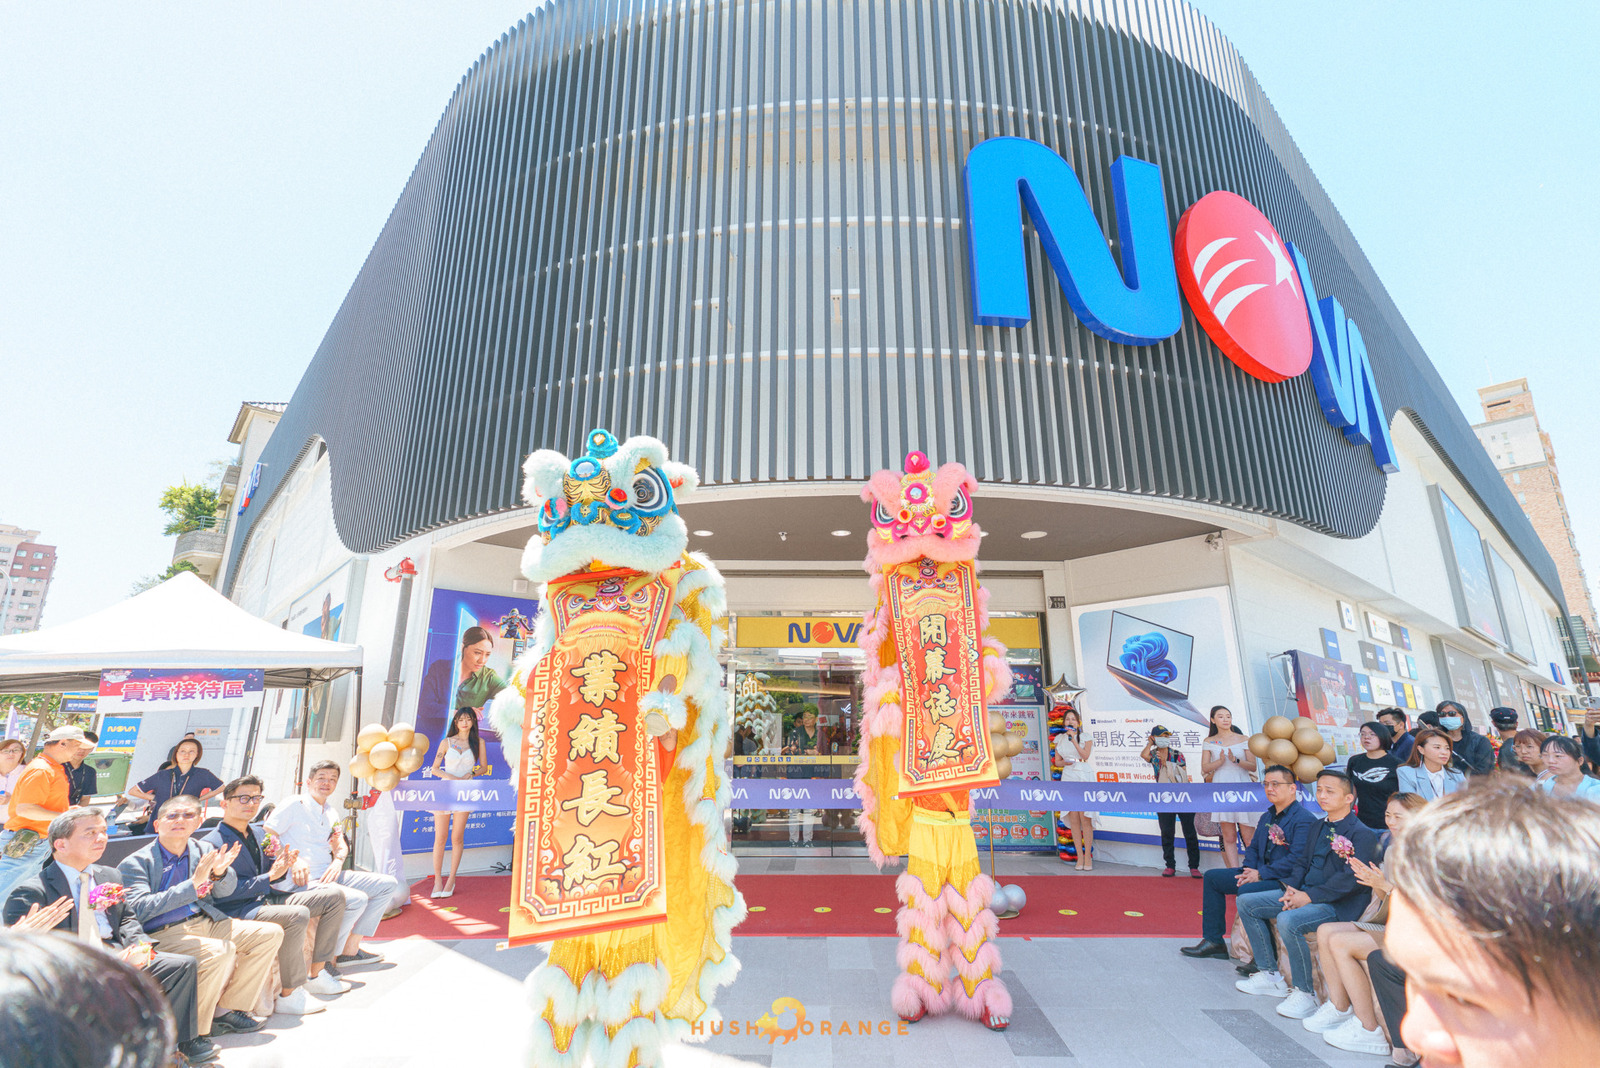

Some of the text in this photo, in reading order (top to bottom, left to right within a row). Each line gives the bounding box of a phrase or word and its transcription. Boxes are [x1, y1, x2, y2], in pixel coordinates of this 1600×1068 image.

[963, 136, 1400, 474] NOVA
[121, 680, 245, 702] 貴賓接待區
[561, 649, 631, 891] 業績長紅
[393, 790, 435, 802] NOVA
[457, 789, 499, 802] NOVA
[731, 788, 749, 800] VA
[769, 788, 811, 800] NOVA
[969, 788, 1000, 800] OVA
[1020, 789, 1063, 802] NOVA
[1084, 790, 1127, 803] NOVA
[1148, 791, 1192, 804] NOVA
[1212, 790, 1258, 803] NOVA
